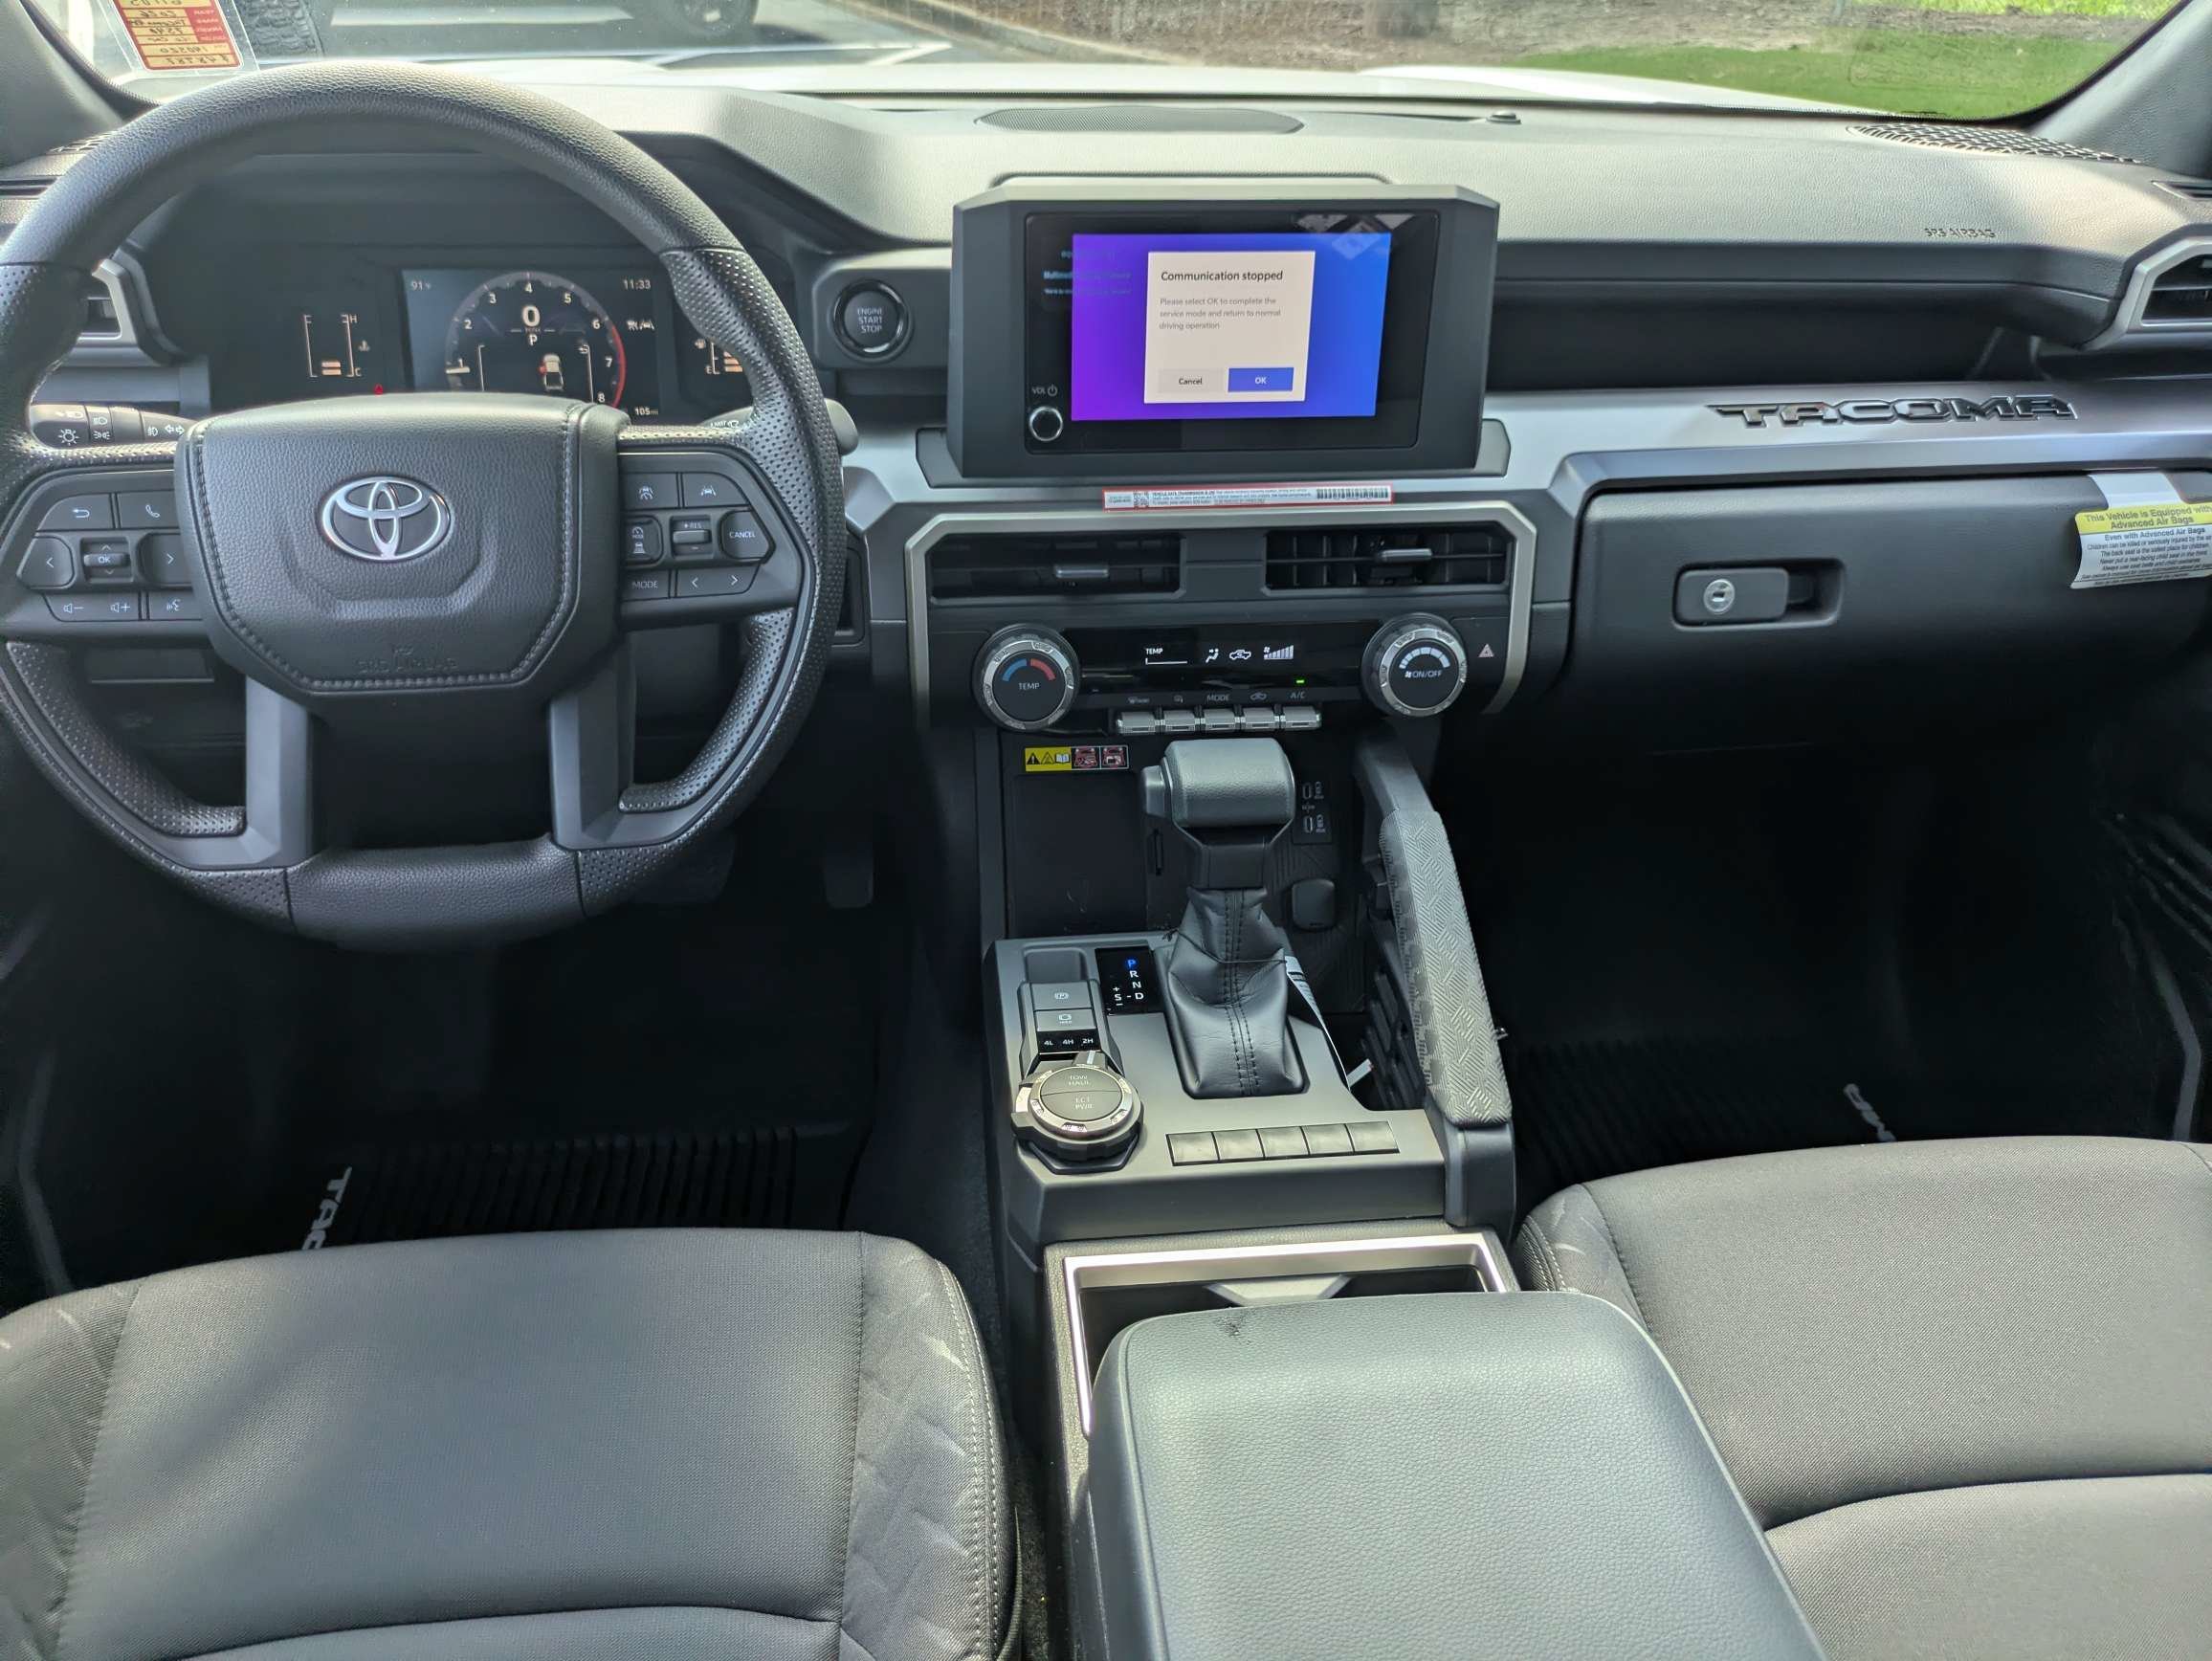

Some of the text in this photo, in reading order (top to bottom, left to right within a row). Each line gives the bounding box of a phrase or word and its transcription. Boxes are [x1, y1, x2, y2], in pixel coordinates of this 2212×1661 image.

[1161, 270, 1283, 282] Communication stopped
[525, 282, 534, 294] 4
[624, 279, 652, 290] 11:33
[489, 293, 497, 304] 3
[564, 293, 572, 304] 5
[1160, 298, 1183, 306] Please
[1184, 298, 1206, 306] select
[1229, 298, 1263, 307] complete
[1255, 308, 1281, 317] normal
[464, 320, 473, 330] 2
[591, 318, 602, 330] 6
[858, 316, 882, 324] START
[861, 324, 882, 334] STOP
[1159, 321, 1184, 331] driving
[529, 334, 539, 346] P
[605, 357, 613, 368] 7
[1178, 377, 1203, 386] Cancel
[598, 392, 606, 404] 8
[1706, 394, 2079, 430] TACOMA
[2086, 514, 2105, 523] This
[2105, 511, 2139, 521] Vehicle
[2140, 509, 2149, 518] is
[2150, 507, 2193, 520] Equipped
[2110, 515, 2195, 530] Advanced Air Bags
[729, 530, 756, 539] CANCEL
[2139, 529, 2175, 539] Advanced
[2176, 527, 2187, 536] Air
[2188, 526, 2206, 535] Bags
[632, 580, 658, 588] MODE
[1412, 670, 1443, 678] ON/OFF
[1018, 682, 1040, 691] TEMP
[1206, 694, 1229, 702] MODE
[1291, 691, 1306, 700] A/C
[1127, 959, 1137, 969] P
